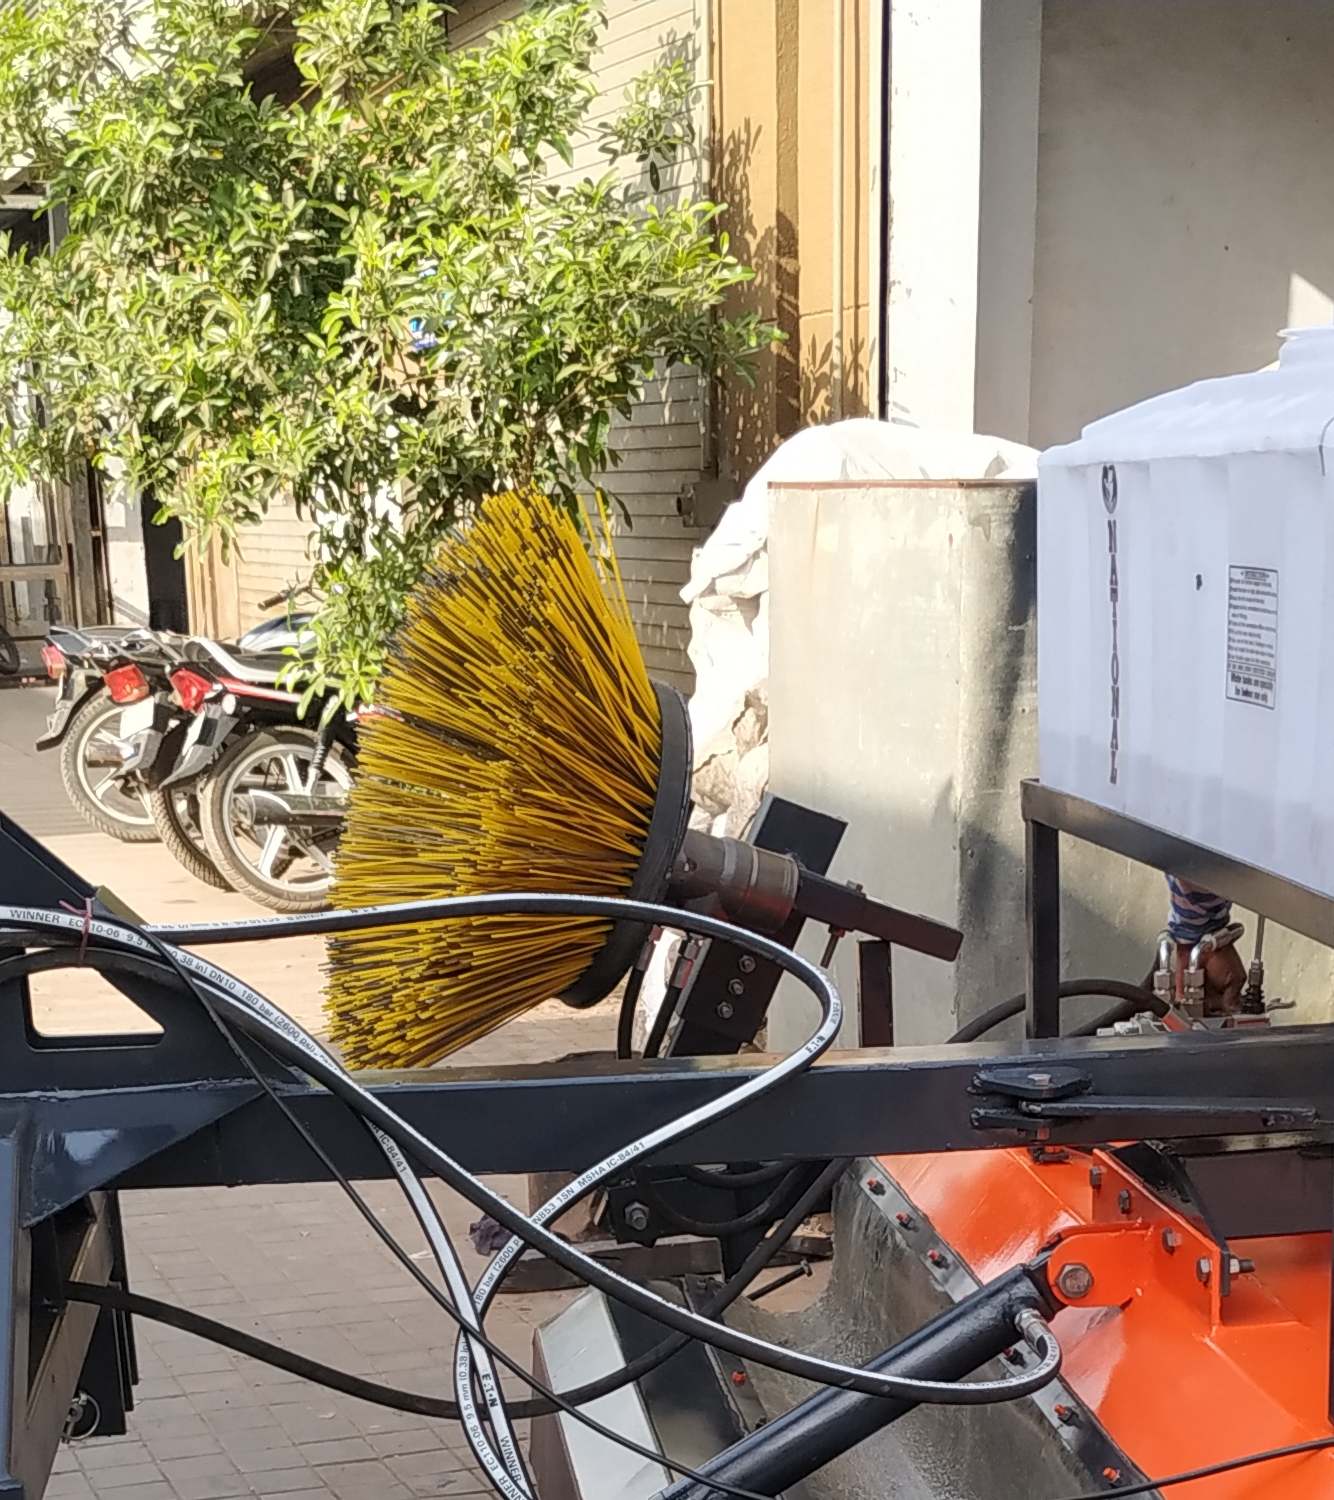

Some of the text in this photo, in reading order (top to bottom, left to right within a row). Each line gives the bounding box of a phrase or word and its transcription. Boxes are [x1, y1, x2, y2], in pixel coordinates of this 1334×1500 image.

[1107, 519, 1119, 784] NATIONAL
[9, 909, 61, 924] WINNER
[126, 932, 144, 947] 9.5
[208, 969, 237, 991] DN10
[241, 989, 260, 1006] 180
[258, 1002, 275, 1018] bar
[273, 1014, 301, 1042] (2600
[606, 1141, 646, 1169] IC-84/41
[577, 1166, 607, 1189] MSHA
[556, 1186, 575, 1203] 1SN
[532, 1201, 557, 1226] N853
[492, 1245, 515, 1273] (2600
[483, 1271, 495, 1288] bar
[459, 1383, 470, 1401] mm
[463, 1402, 474, 1421] 9.5
[471, 1424, 499, 1472] EC110-06
[500, 1435, 523, 1481] WINNER
